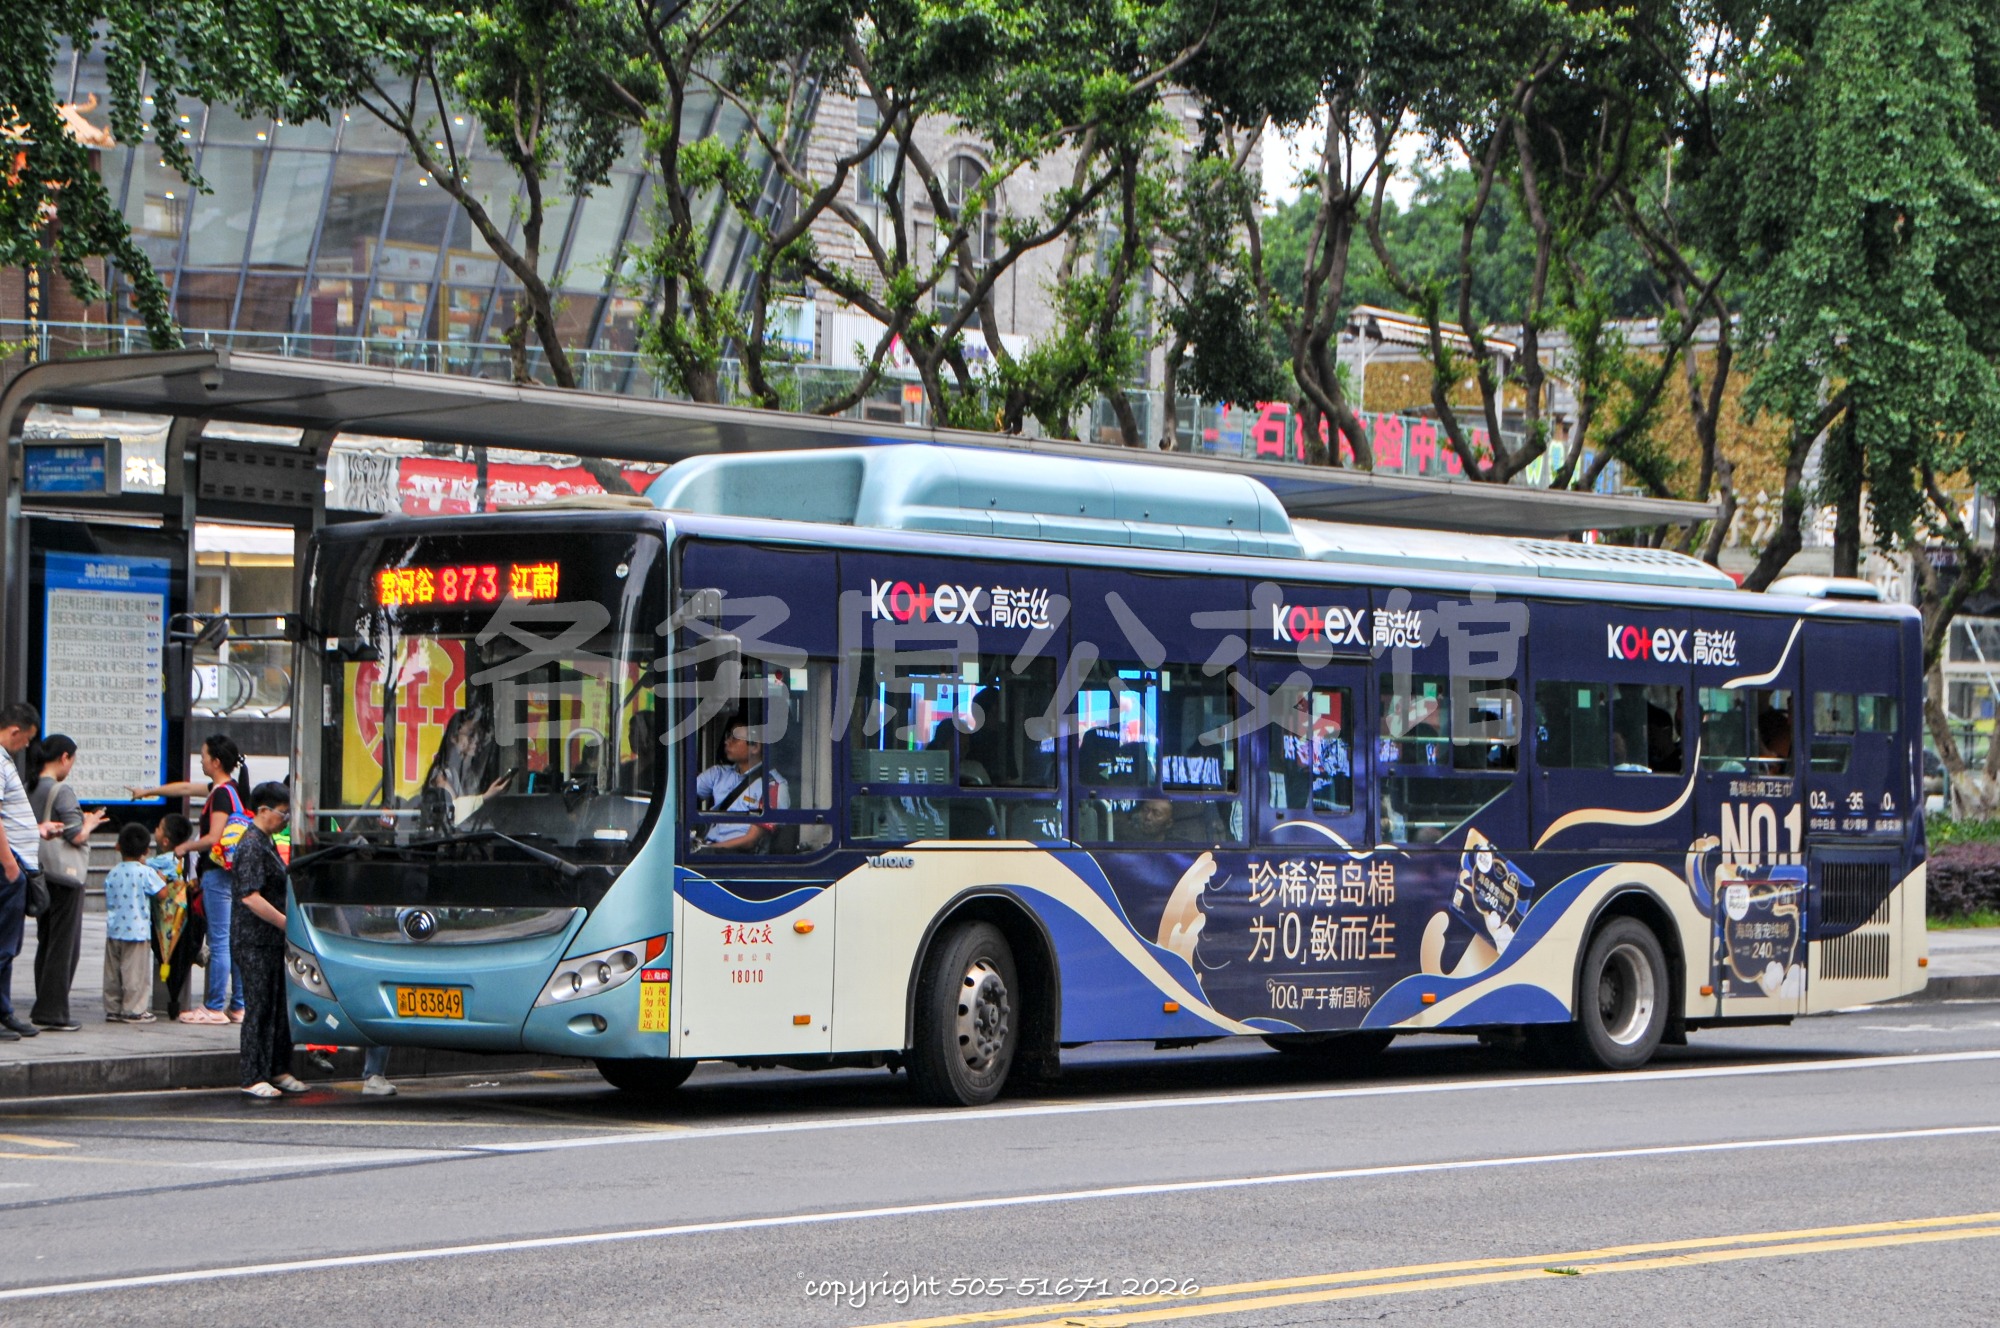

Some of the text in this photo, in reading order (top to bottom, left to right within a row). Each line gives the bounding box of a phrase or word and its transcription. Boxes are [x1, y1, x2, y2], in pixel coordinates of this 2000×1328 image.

[442, 567, 498, 602] 873
[871, 578, 1050, 629] Kotex 高洁丝
[1272, 603, 1422, 648] Kotex 高洁丝
[1607, 624, 1738, 667] Kotex 高洁丝
[865, 855, 915, 868] YUTONG
[1247, 860, 1395, 908] 珍稀海岛棉
[1484, 892, 1499, 909] 240
[720, 924, 773, 945] 重庆公交
[1752, 941, 1773, 959] 240
[731, 969, 763, 984] 18010
